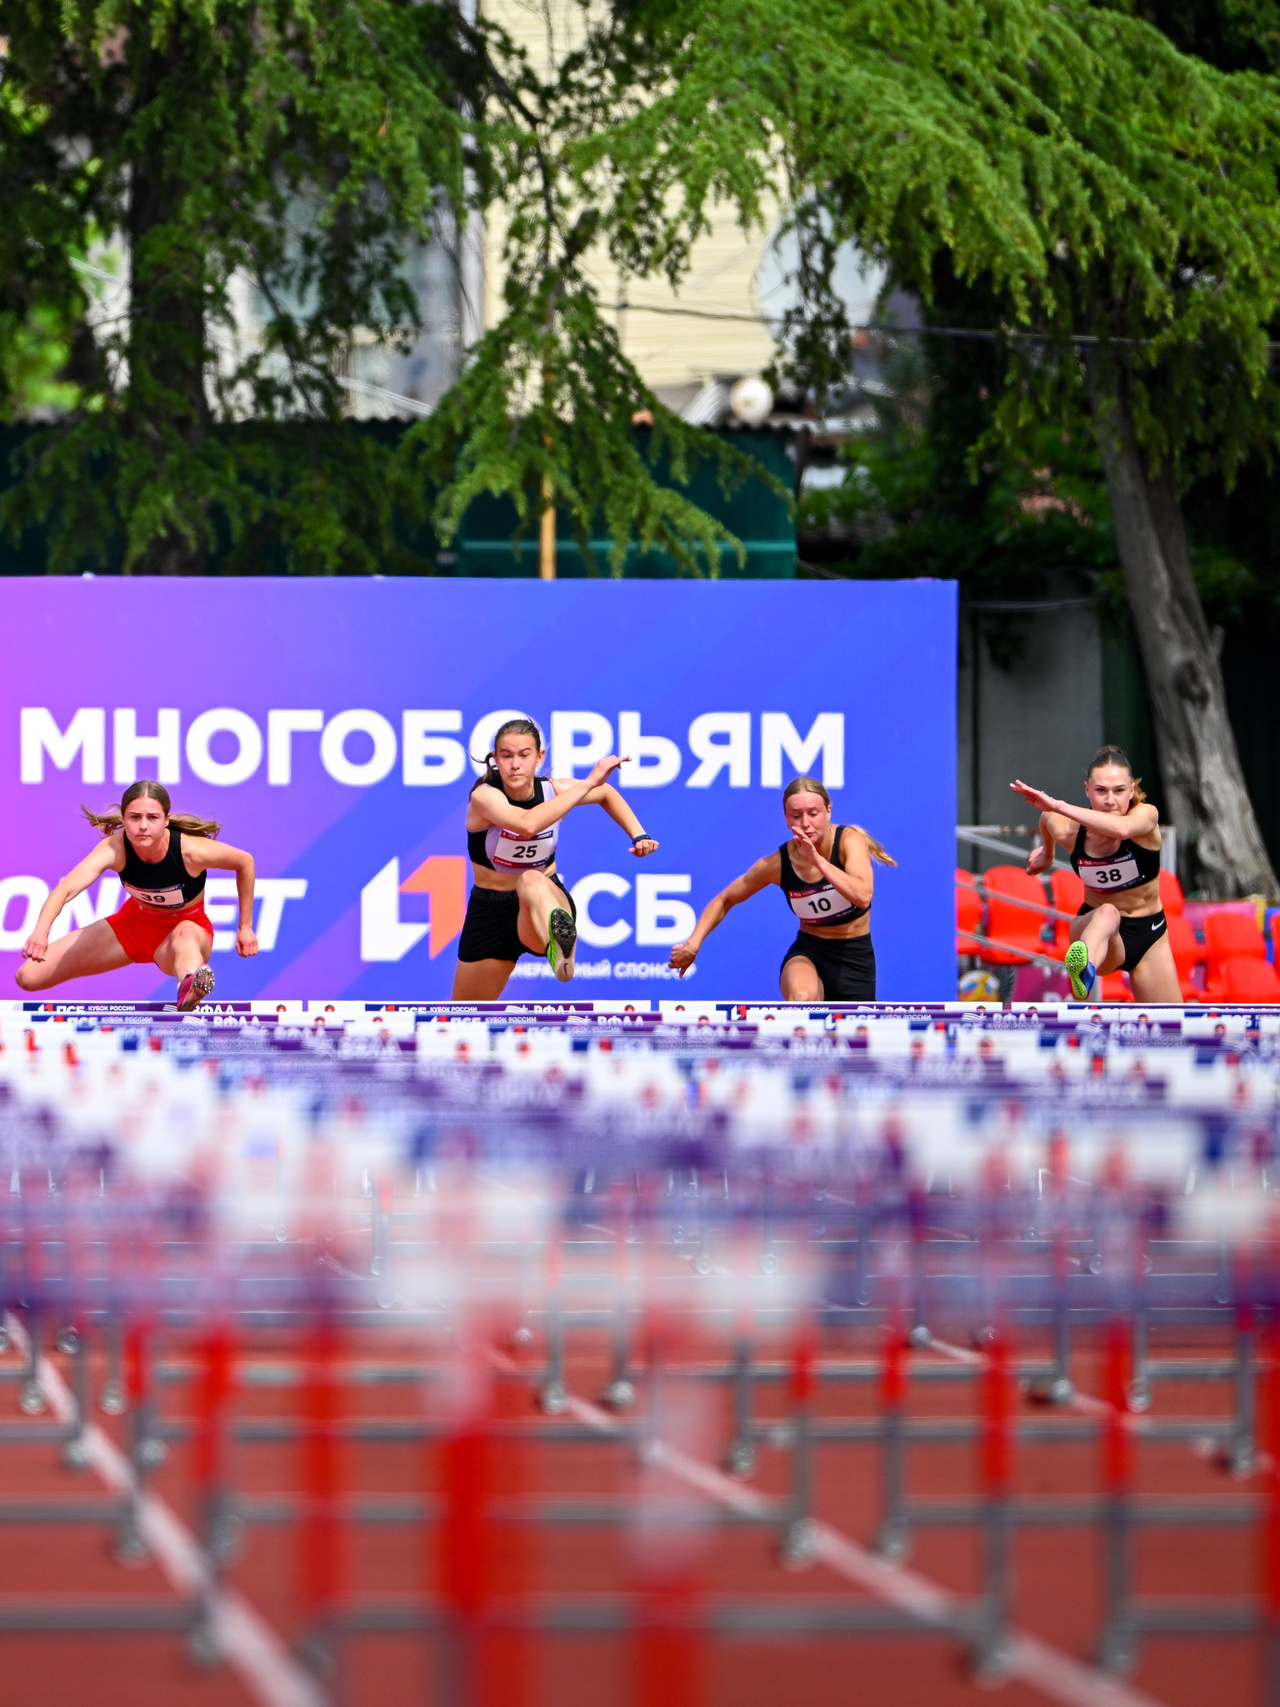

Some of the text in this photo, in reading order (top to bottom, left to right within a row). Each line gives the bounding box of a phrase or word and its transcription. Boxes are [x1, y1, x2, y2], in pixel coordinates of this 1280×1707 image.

[20, 707, 845, 789] МНОГОБОРЬЯМ
[512, 845, 537, 859] 25
[1095, 868, 1122, 883] 38
[140, 893, 166, 903] 39
[808, 897, 831, 914] 10
[557, 872, 697, 948] СБ
